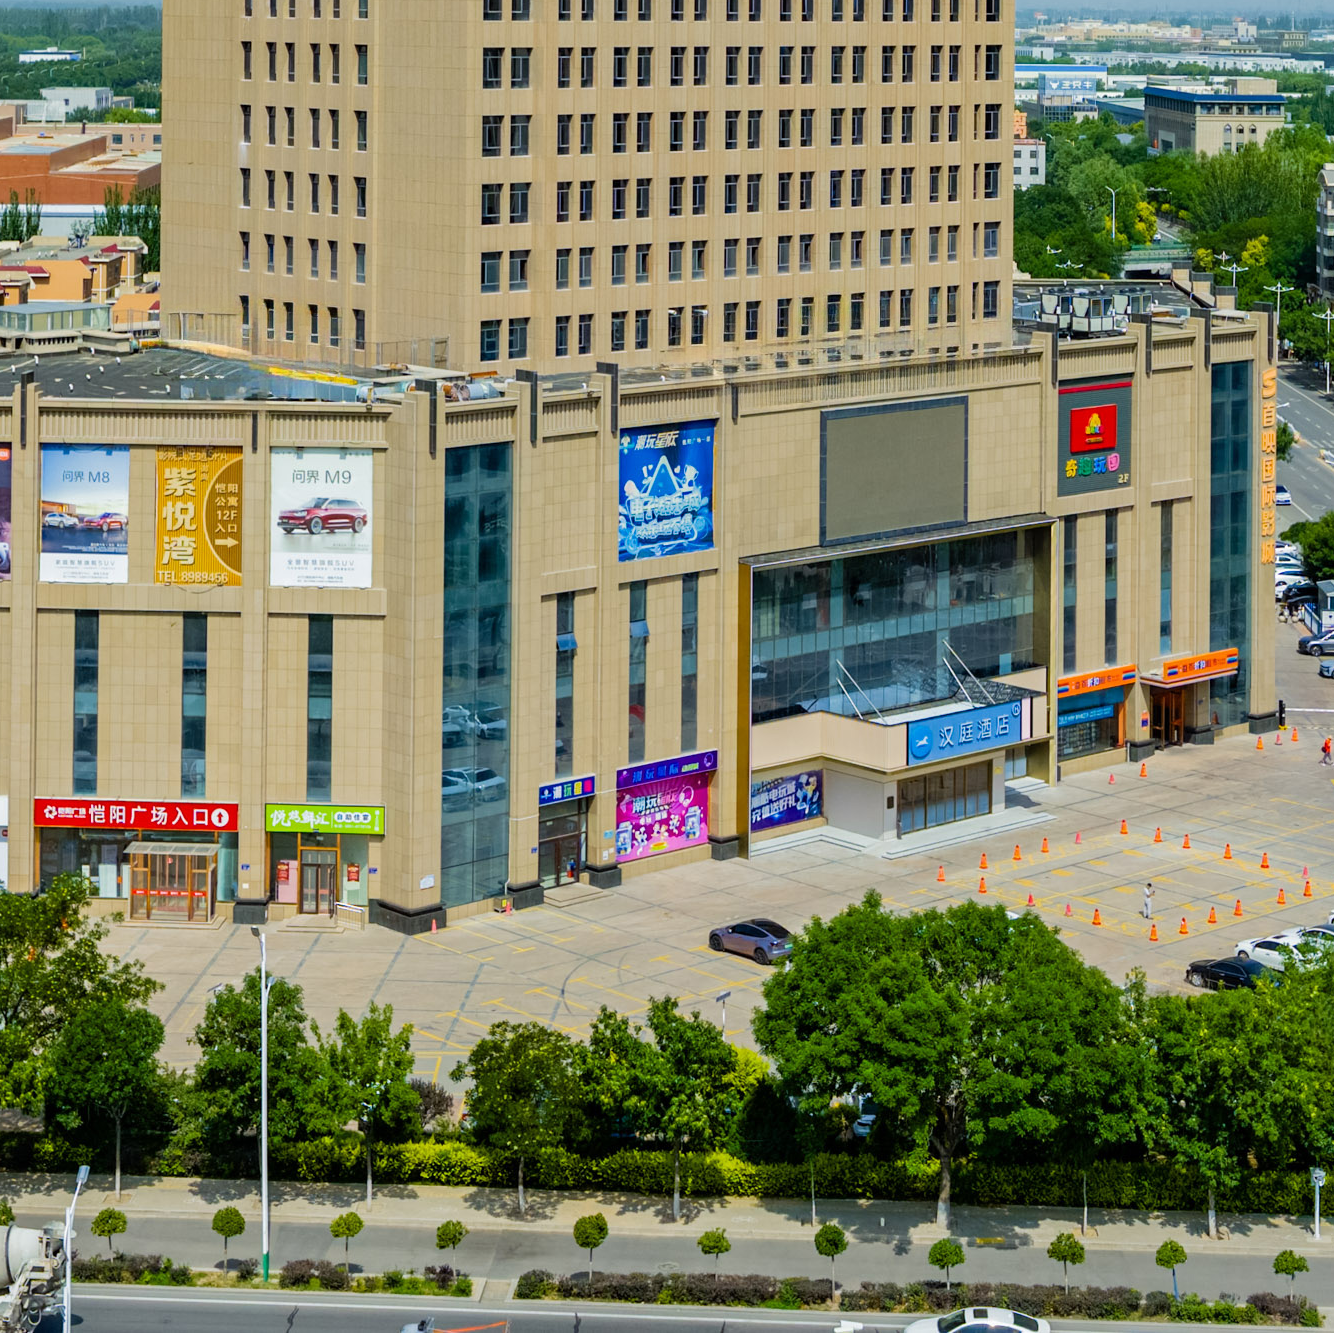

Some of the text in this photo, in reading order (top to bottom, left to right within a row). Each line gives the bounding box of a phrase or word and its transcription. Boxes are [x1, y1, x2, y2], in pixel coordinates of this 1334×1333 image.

[62, 470, 110, 483] 问界 M8
[292, 470, 352, 484] 问界 M9
[1118, 473, 1129, 484] 2F
[215, 483, 238, 494] 恺阳
[215, 497, 238, 507] 公寓
[161, 467, 197, 566] 紫悦湾
[216, 511, 237, 521] 12F
[215, 524, 237, 533] 入口
[939, 714, 1009, 747] 汉庭酒店
[88, 803, 209, 826] 恺阳广场入口
[270, 809, 329, 829] 悦烤鲜汇
